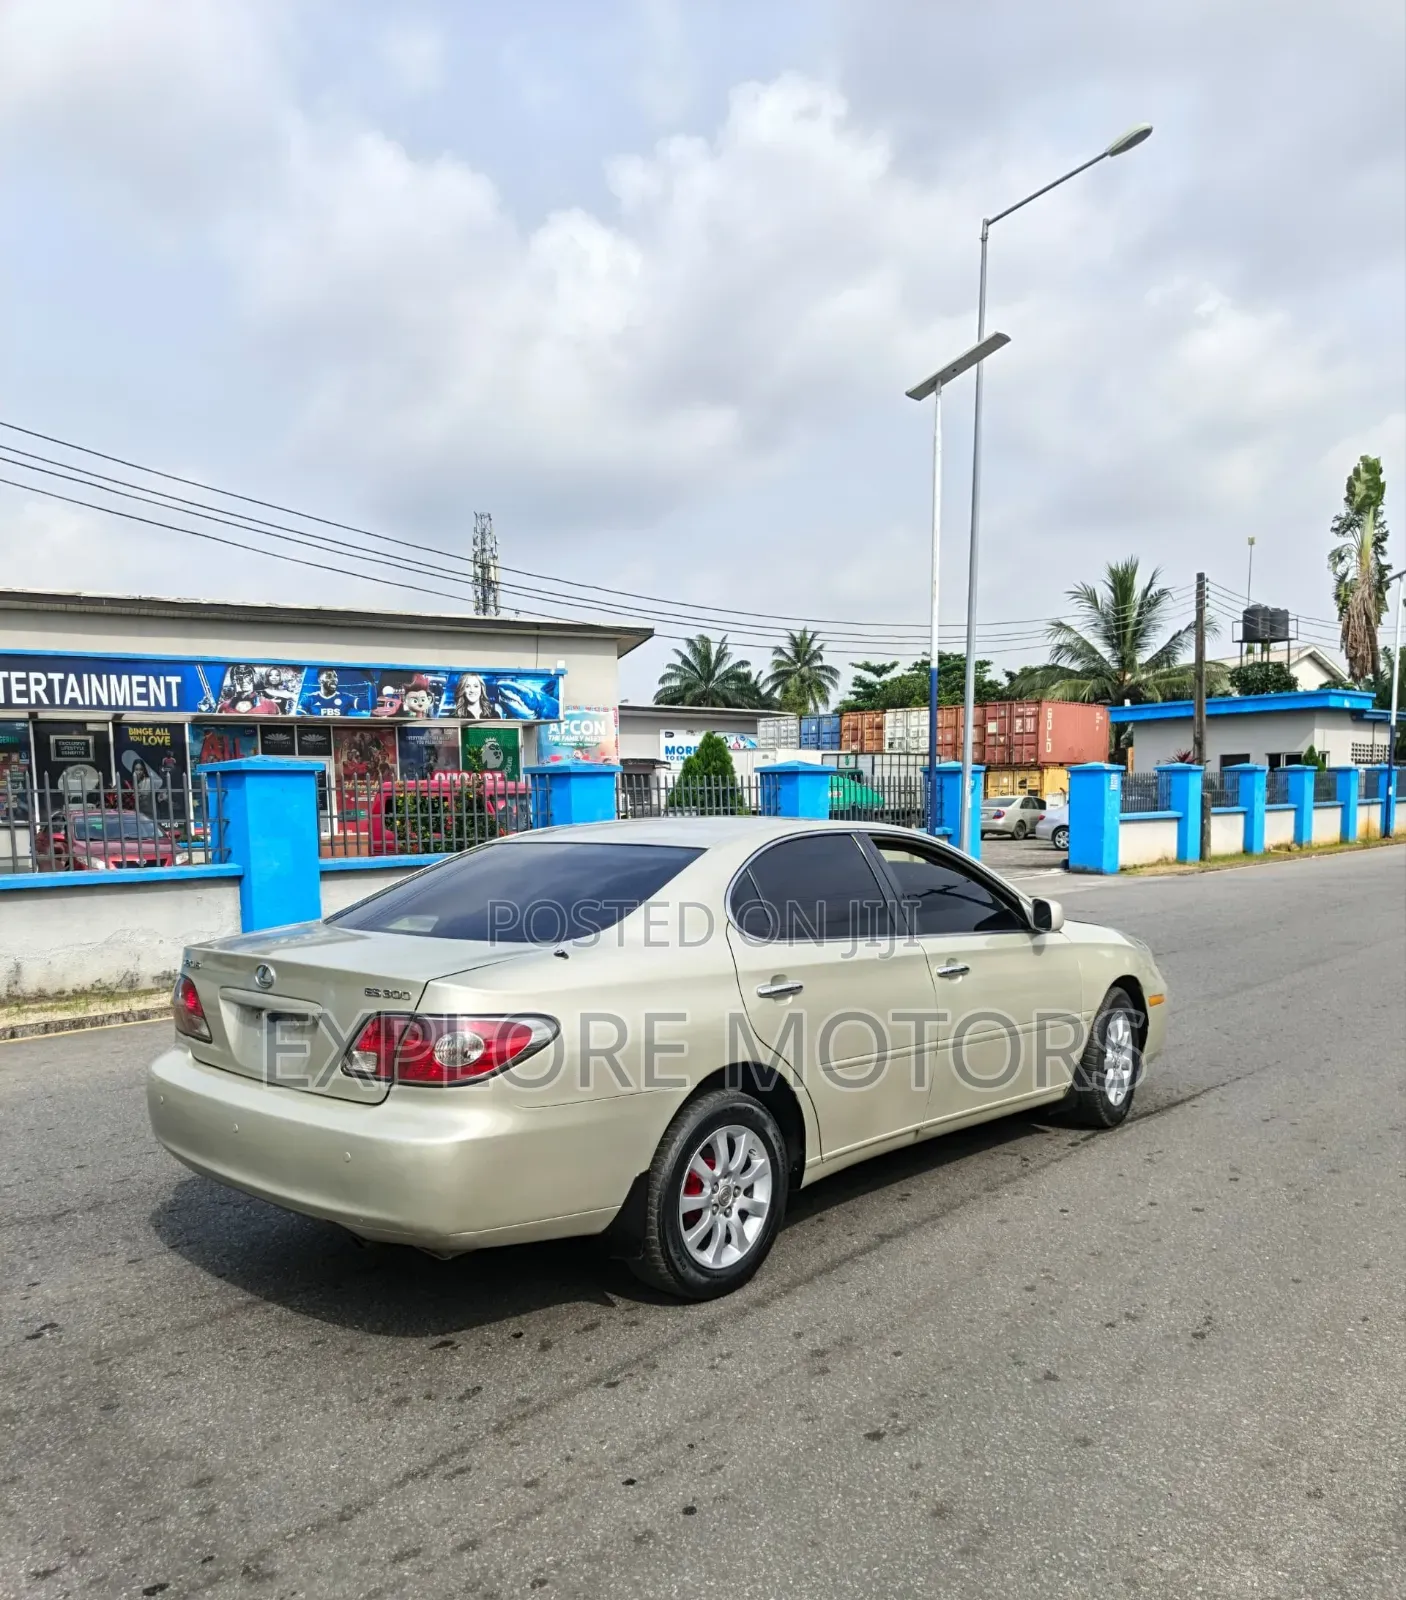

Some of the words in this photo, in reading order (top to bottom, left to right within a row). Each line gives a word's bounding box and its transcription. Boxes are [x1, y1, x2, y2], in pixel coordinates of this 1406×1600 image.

[0, 671, 182, 707] TERTAINMENT
[320, 708, 341, 716] FBS
[128, 727, 153, 736] BINGE
[155, 727, 170, 736] ALL
[547, 720, 606, 735] AFCON
[142, 735, 171, 746] LOVE
[364, 987, 382, 998] ES
[382, 989, 411, 1001] 300
